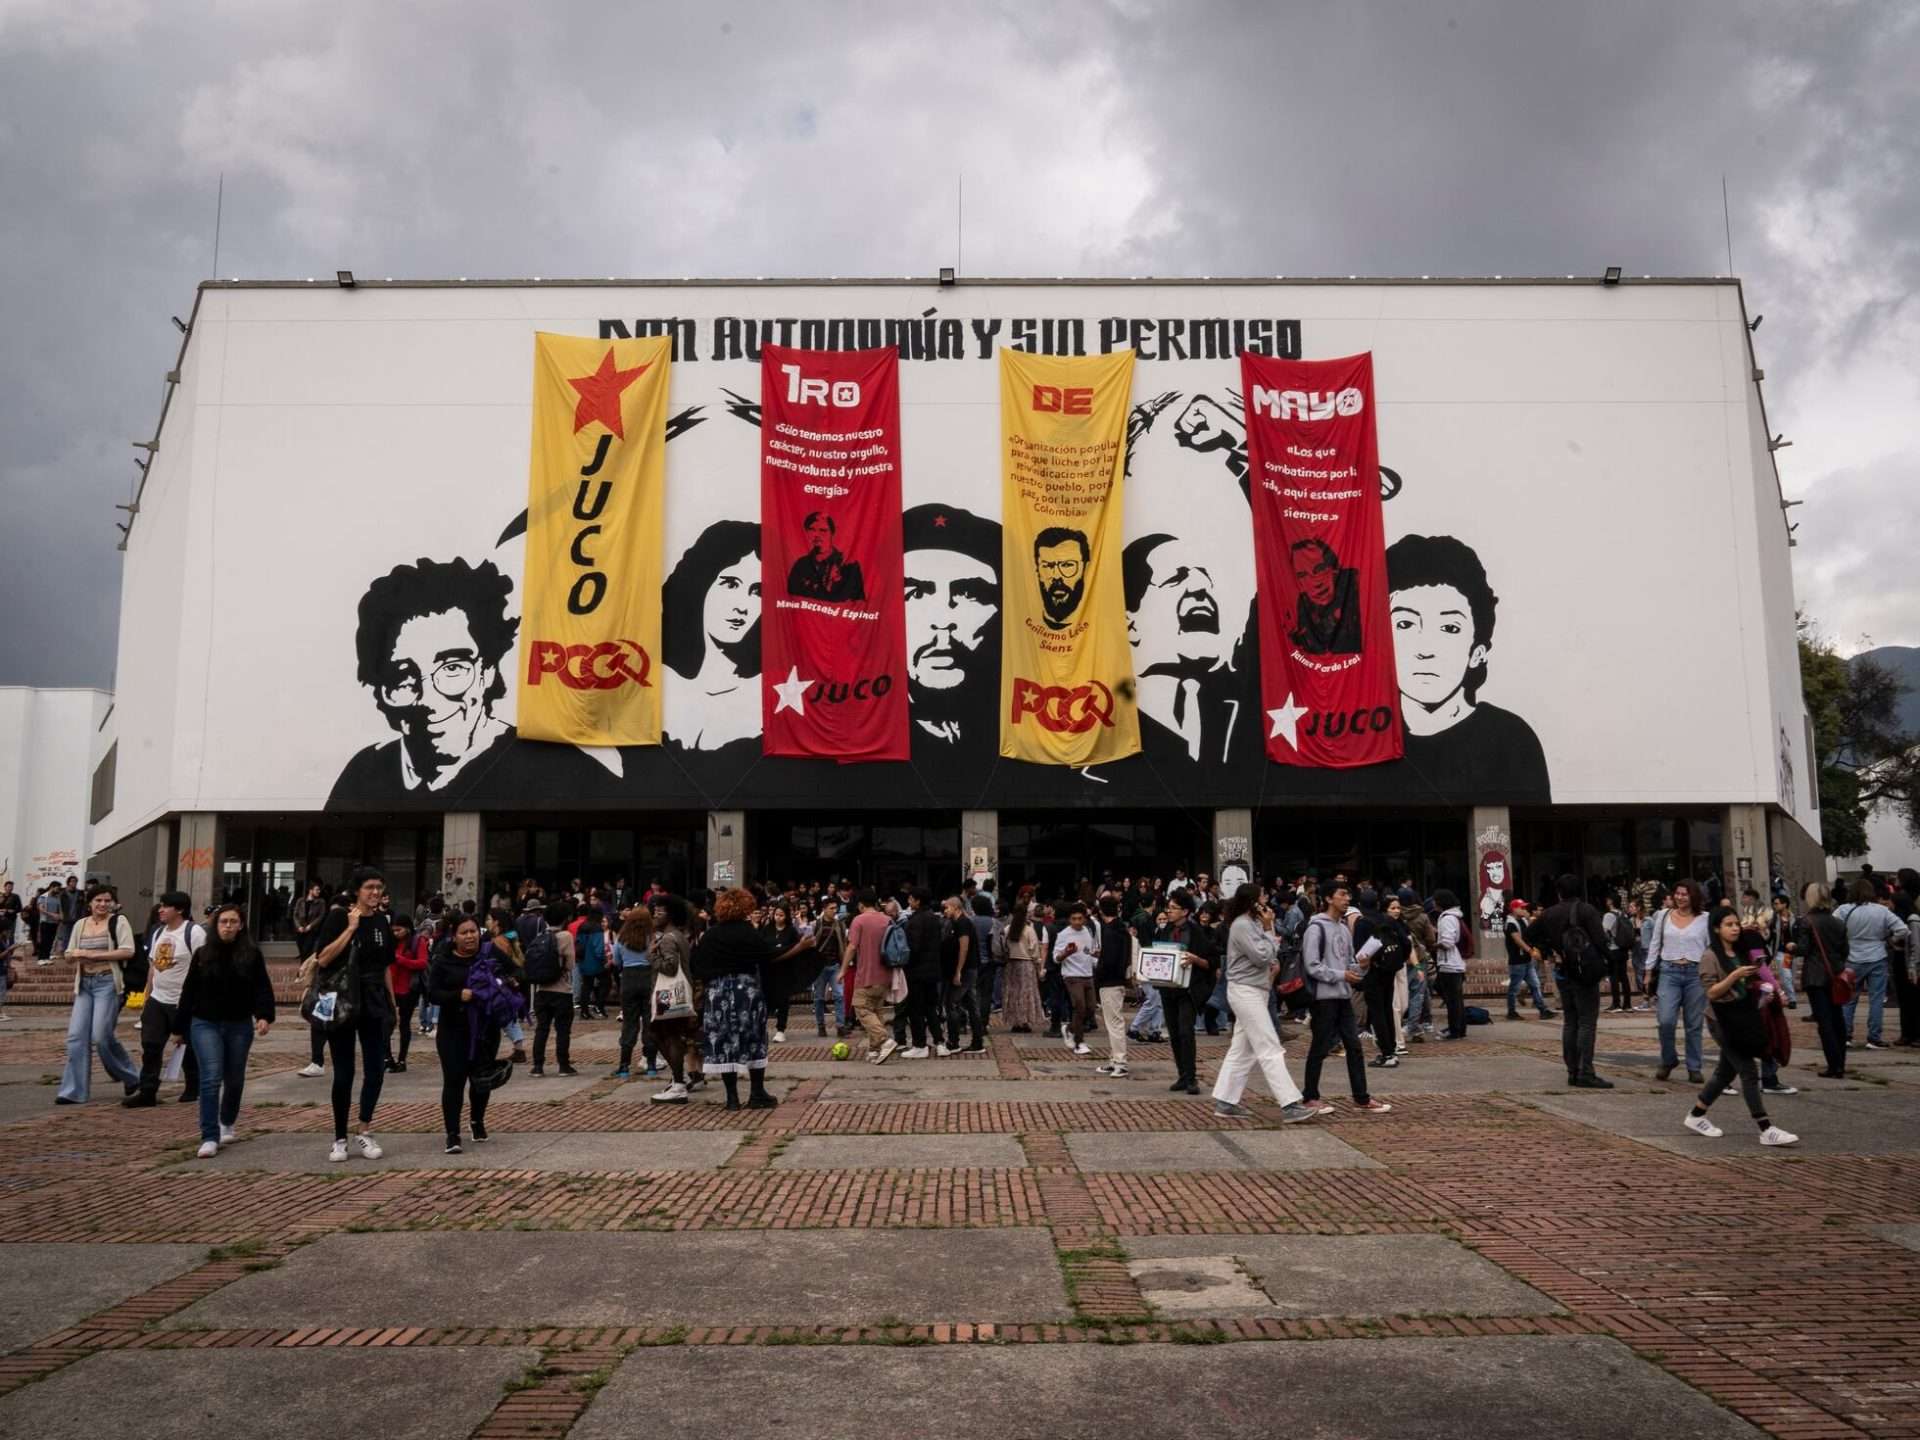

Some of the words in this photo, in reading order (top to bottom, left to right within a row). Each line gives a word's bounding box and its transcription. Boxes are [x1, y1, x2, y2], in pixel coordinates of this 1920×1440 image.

[711, 306, 965, 363] AUTONOMÍA
[971, 318, 1002, 360] Y
[1011, 318, 1086, 356] SIN
[1098, 317, 1303, 361] PERMISO
[781, 363, 861, 408] 1RO
[1032, 384, 1094, 415] DE
[1252, 384, 1364, 422] MAYO
[799, 429, 844, 442] tenemos
[845, 428, 884, 441] nuestro
[809, 449, 848, 460] nuestro
[850, 444, 888, 461] orgullo,
[1315, 448, 1336, 460] que
[766, 455, 797, 471] nuestra
[798, 463, 845, 477] voluntad
[847, 468, 854, 480] y
[855, 462, 894, 476] nuestra
[1031, 455, 1048, 467] que
[1051, 456, 1080, 466] luche
[1083, 457, 1101, 469] por
[1330, 470, 1348, 481] por
[804, 483, 849, 499] energía»
[1045, 482, 1085, 494] pueblo,
[1284, 488, 1308, 500] aquí
[1061, 495, 1071, 505] la
[1073, 495, 1106, 505] nueva
[566, 434, 614, 616] JUCO
[842, 609, 880, 621] Espinal
[1314, 663, 1342, 673] Pardo
[1343, 654, 1361, 669] Leal
[809, 674, 892, 705] JUCO
[1305, 705, 1392, 738] JUCO
